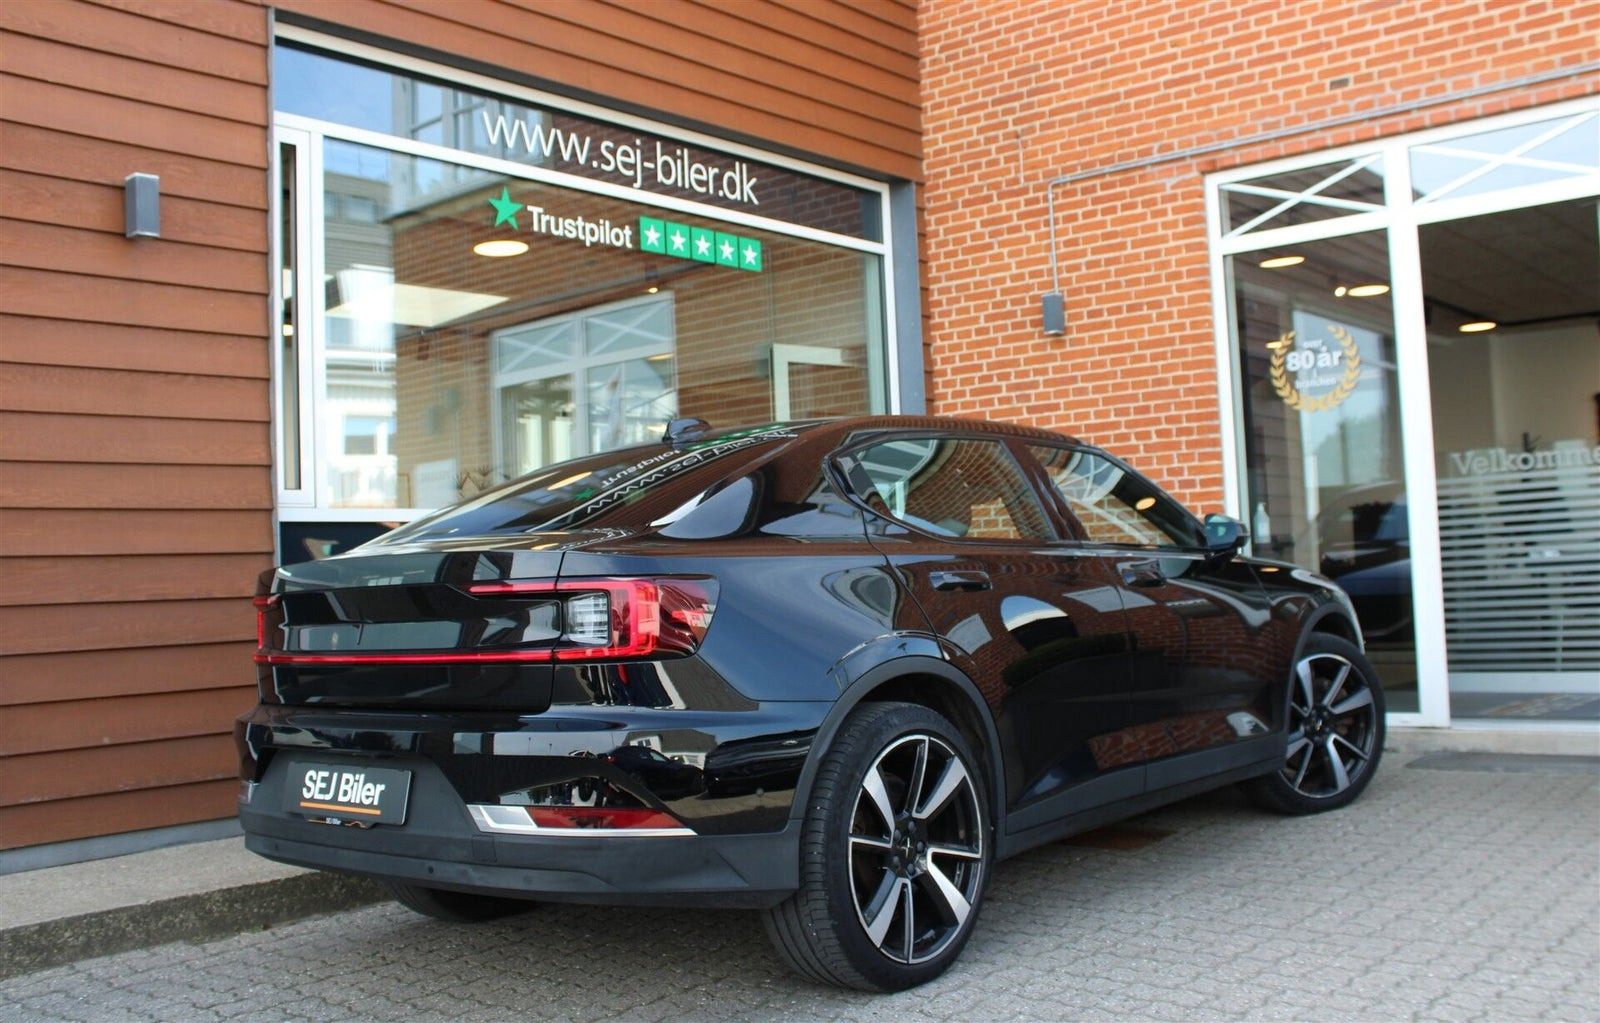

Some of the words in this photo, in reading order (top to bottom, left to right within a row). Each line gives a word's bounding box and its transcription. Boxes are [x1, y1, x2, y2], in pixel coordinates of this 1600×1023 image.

[482, 111, 760, 206] www.sej-biler.dk
[526, 204, 633, 249] Trustpilot
[1285, 350, 1315, 372] 80
[1317, 344, 1343, 368] år
[302, 769, 338, 801] SEJ
[337, 772, 386, 806] Biler
